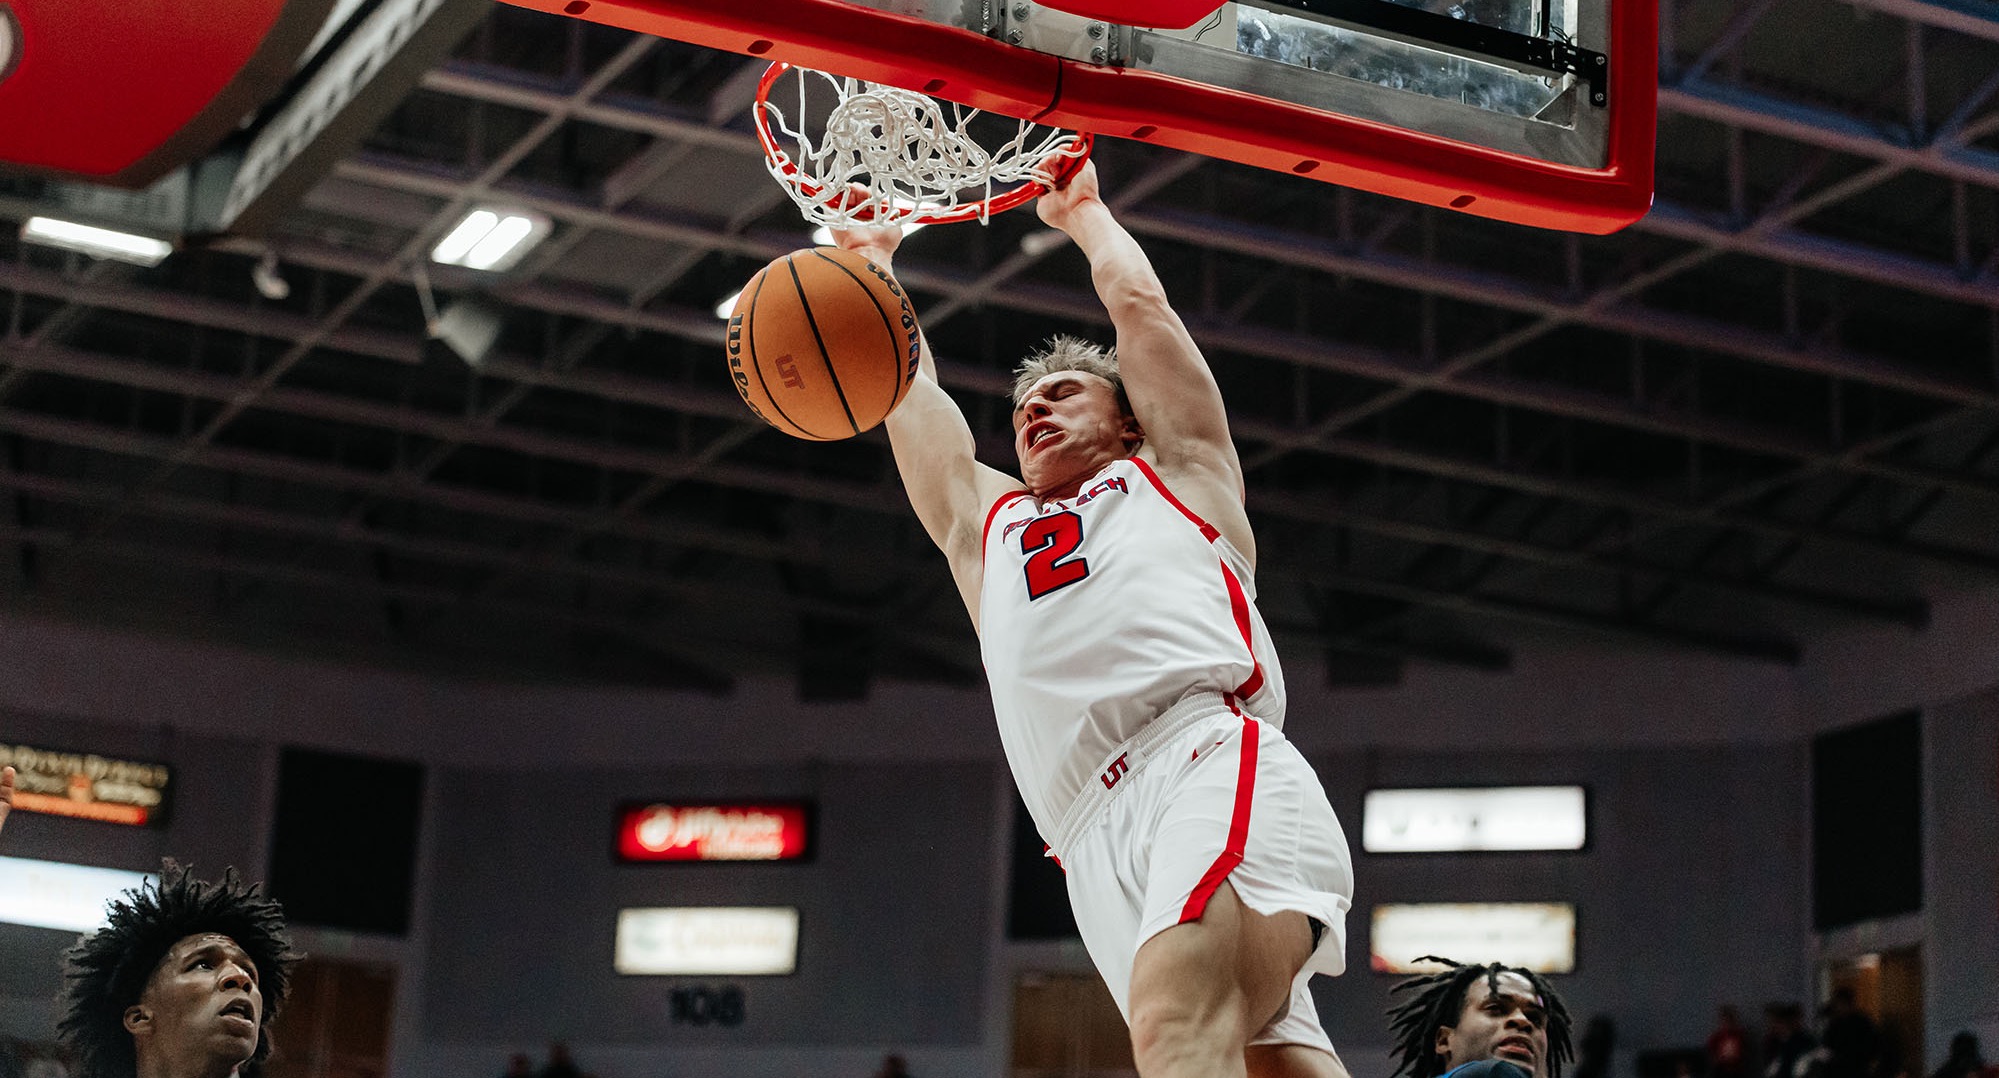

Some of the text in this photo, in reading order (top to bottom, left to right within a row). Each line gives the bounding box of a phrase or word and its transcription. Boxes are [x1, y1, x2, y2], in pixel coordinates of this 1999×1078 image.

[865, 262, 921, 386] Wilson
[728, 312, 784, 431] Wilso
[775, 353, 805, 390] UT
[1020, 510, 1090, 602] 2
[1101, 751, 1129, 790] UT
